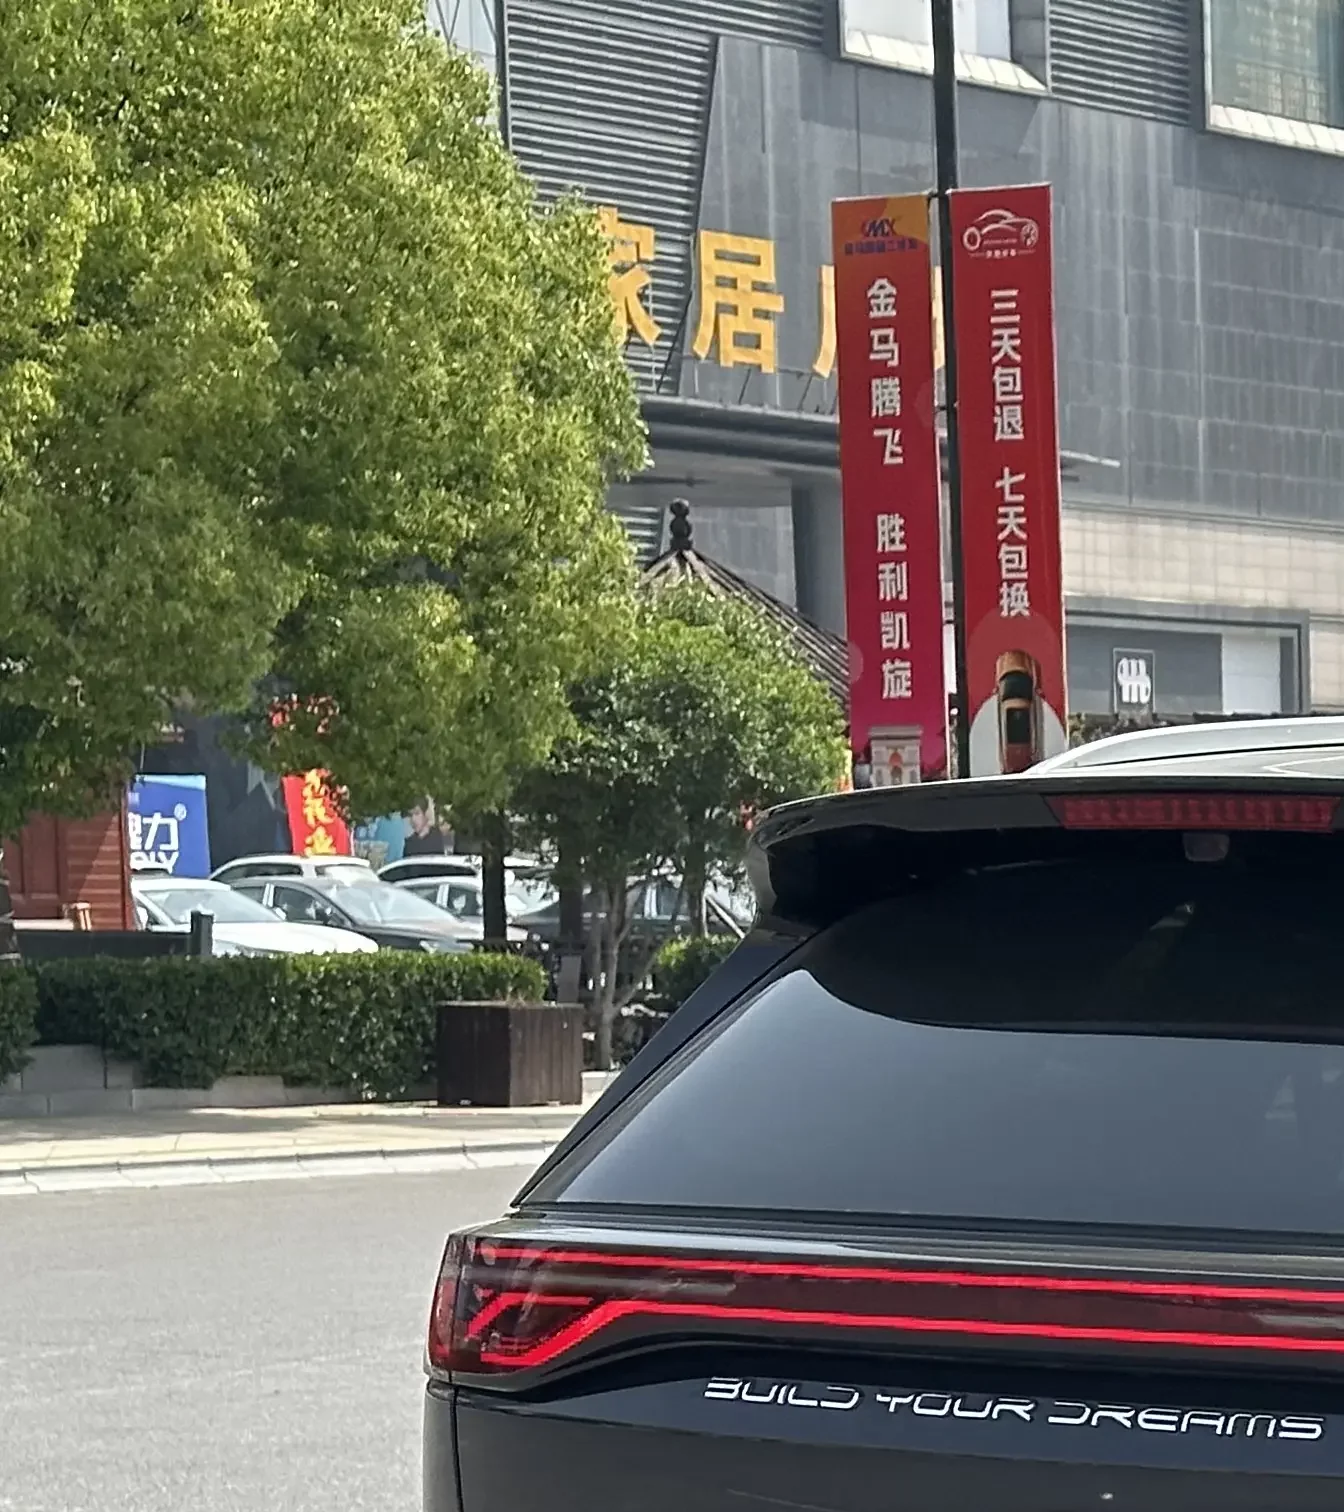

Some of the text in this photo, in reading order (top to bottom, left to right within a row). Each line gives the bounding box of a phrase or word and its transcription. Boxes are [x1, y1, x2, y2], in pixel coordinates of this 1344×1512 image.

[867, 278, 904, 466] 金马腾飞
[990, 288, 1025, 442] 三天包退
[877, 514, 912, 699] 胜利凯旋
[995, 467, 1031, 618] 七天包换
[704, 1376, 1324, 1439] BUILD YOUR DREAMS
